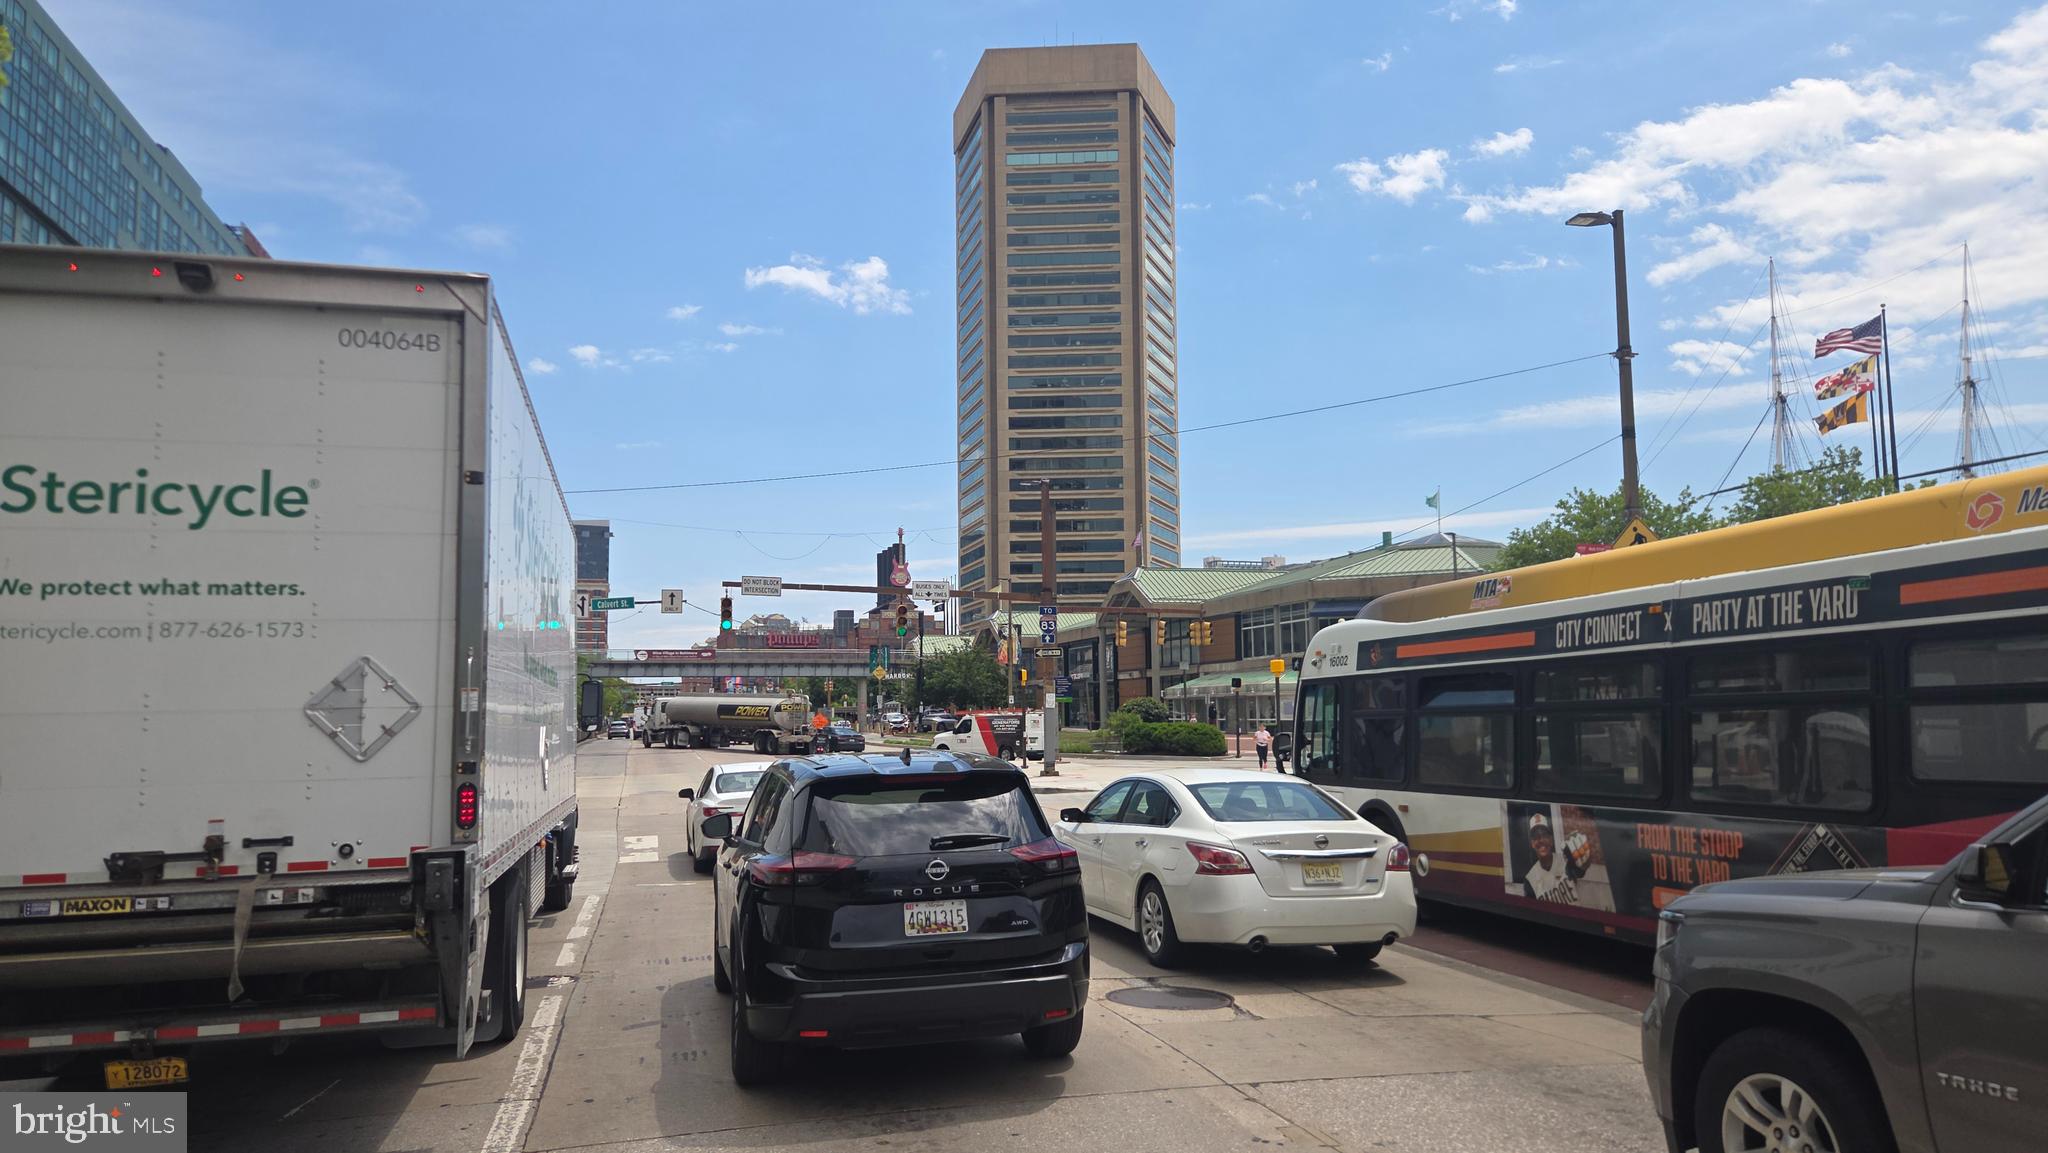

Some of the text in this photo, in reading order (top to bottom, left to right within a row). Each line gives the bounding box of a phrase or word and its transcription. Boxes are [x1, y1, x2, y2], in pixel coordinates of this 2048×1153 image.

[337, 327, 441, 352] 004064B
[0, 578, 306, 600] We protect what matters.
[1473, 578, 1498, 599] MTA
[597, 600, 619, 609] Calvert
[1556, 619, 1581, 648] CITY
[1584, 610, 1642, 645] CONNECT
[1692, 597, 1742, 634] PARTY
[1746, 595, 1766, 629] AT
[1770, 590, 1803, 626] THE
[1809, 583, 1859, 622] YARD
[159, 622, 305, 639] 877-626-1573
[1041, 621, 1055, 630] 83
[1329, 655, 1349, 667] 16002
[735, 705, 770, 717] POWER
[1636, 823, 1743, 859] FROM THE STOOP
[1651, 853, 1731, 885] TO THE YARD
[893, 884, 980, 897] ROGUE
[65, 898, 127, 913] MAXON
[123, 1064, 182, 1081] 128072
[1936, 1071, 2019, 1101] TAHOE
